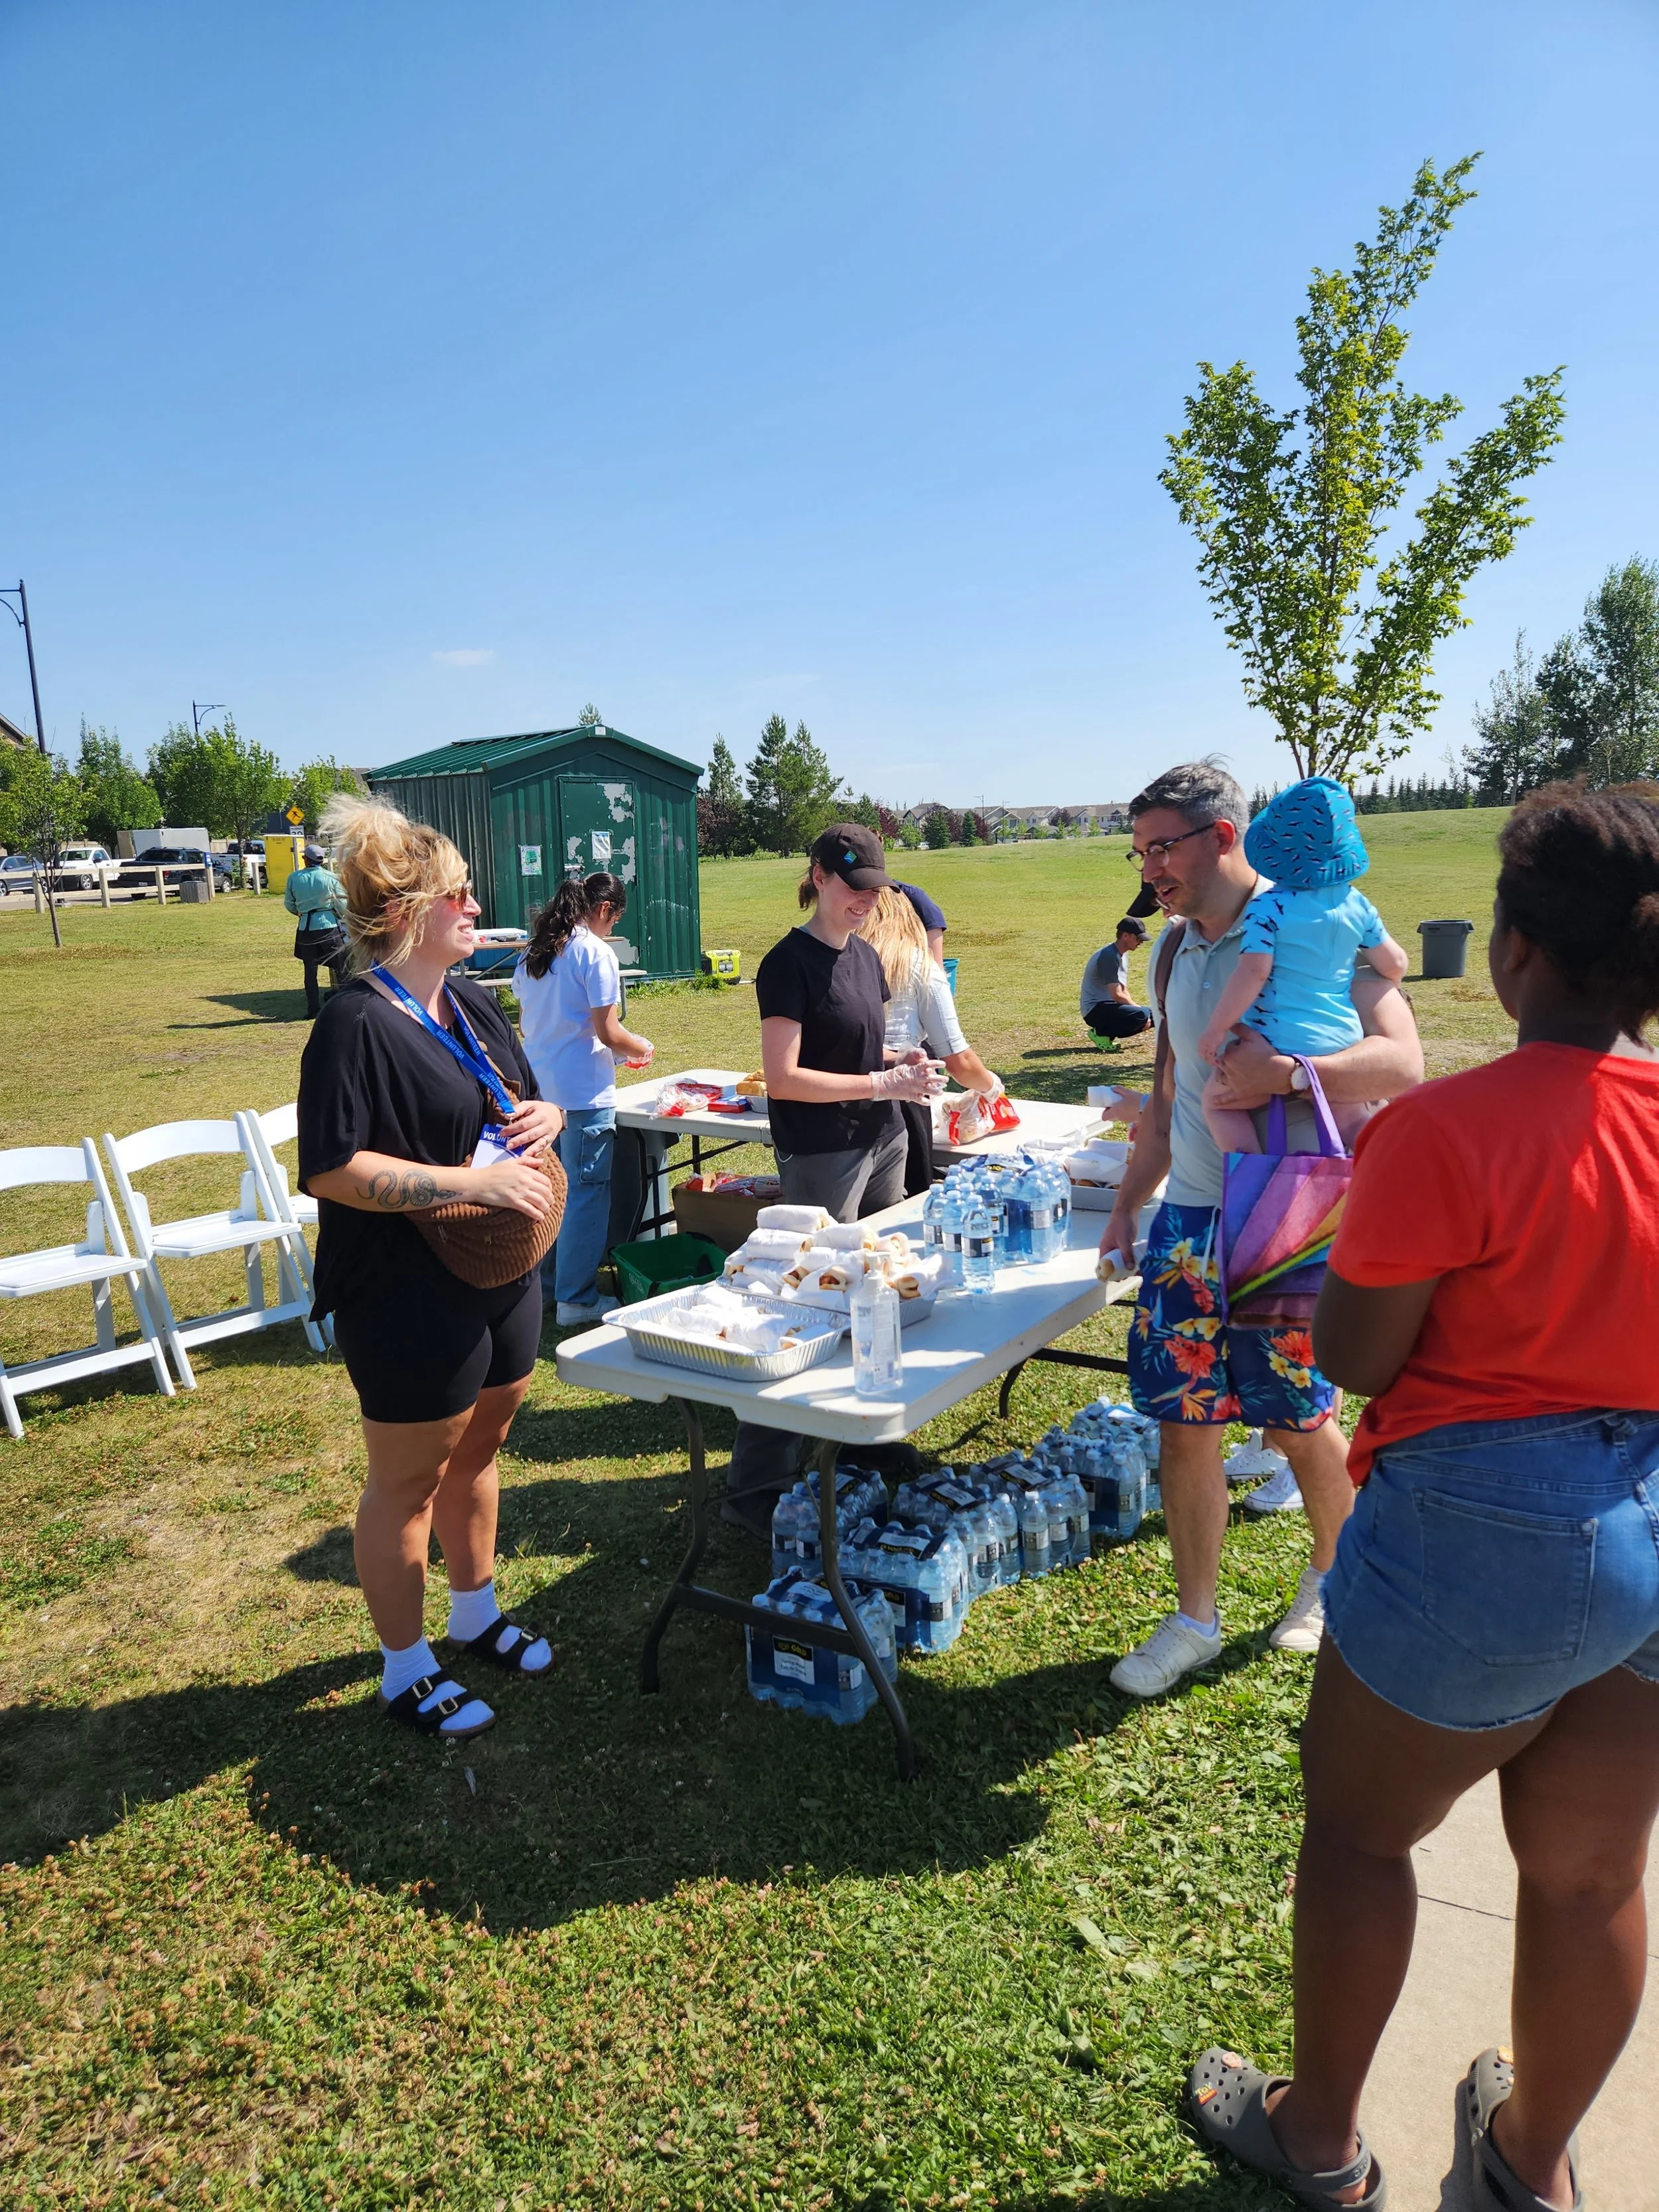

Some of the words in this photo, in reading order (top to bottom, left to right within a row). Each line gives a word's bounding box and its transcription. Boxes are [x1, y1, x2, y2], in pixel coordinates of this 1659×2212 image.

[394, 986, 423, 1016] VOLUNTEER
[436, 1029, 465, 1060] VOLUNTEER
[464, 1025, 481, 1056] VOLUNTEER
[483, 1131, 512, 1142] VOLUNT
[1195, 2081, 1212, 2096] TOY
